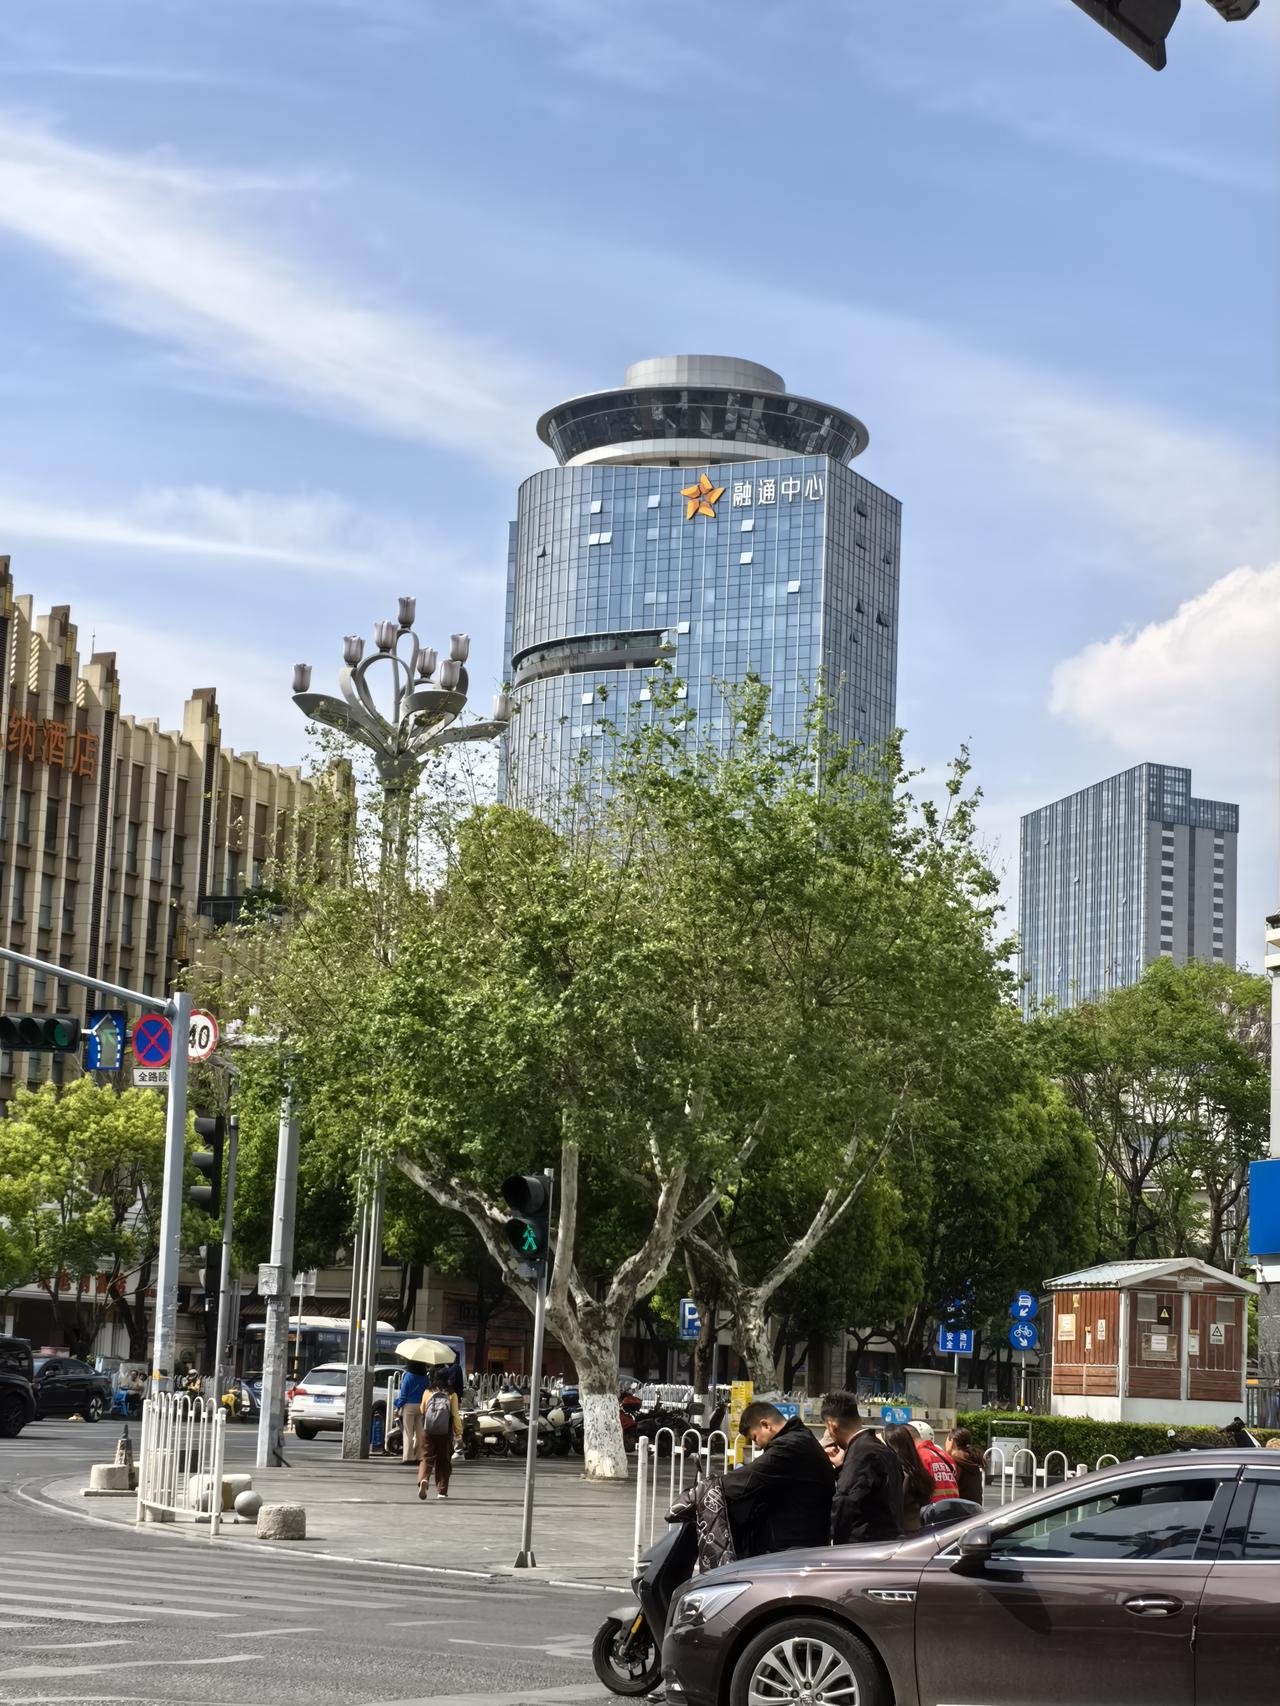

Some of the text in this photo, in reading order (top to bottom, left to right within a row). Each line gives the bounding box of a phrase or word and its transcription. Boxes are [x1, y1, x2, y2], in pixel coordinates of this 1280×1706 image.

[733, 474, 824, 507] 融通中心
[0, 707, 99, 781] 纳酒店
[188, 1024, 210, 1049] 40
[138, 1071, 168, 1082] 全路段
[684, 1302, 699, 1329] P
